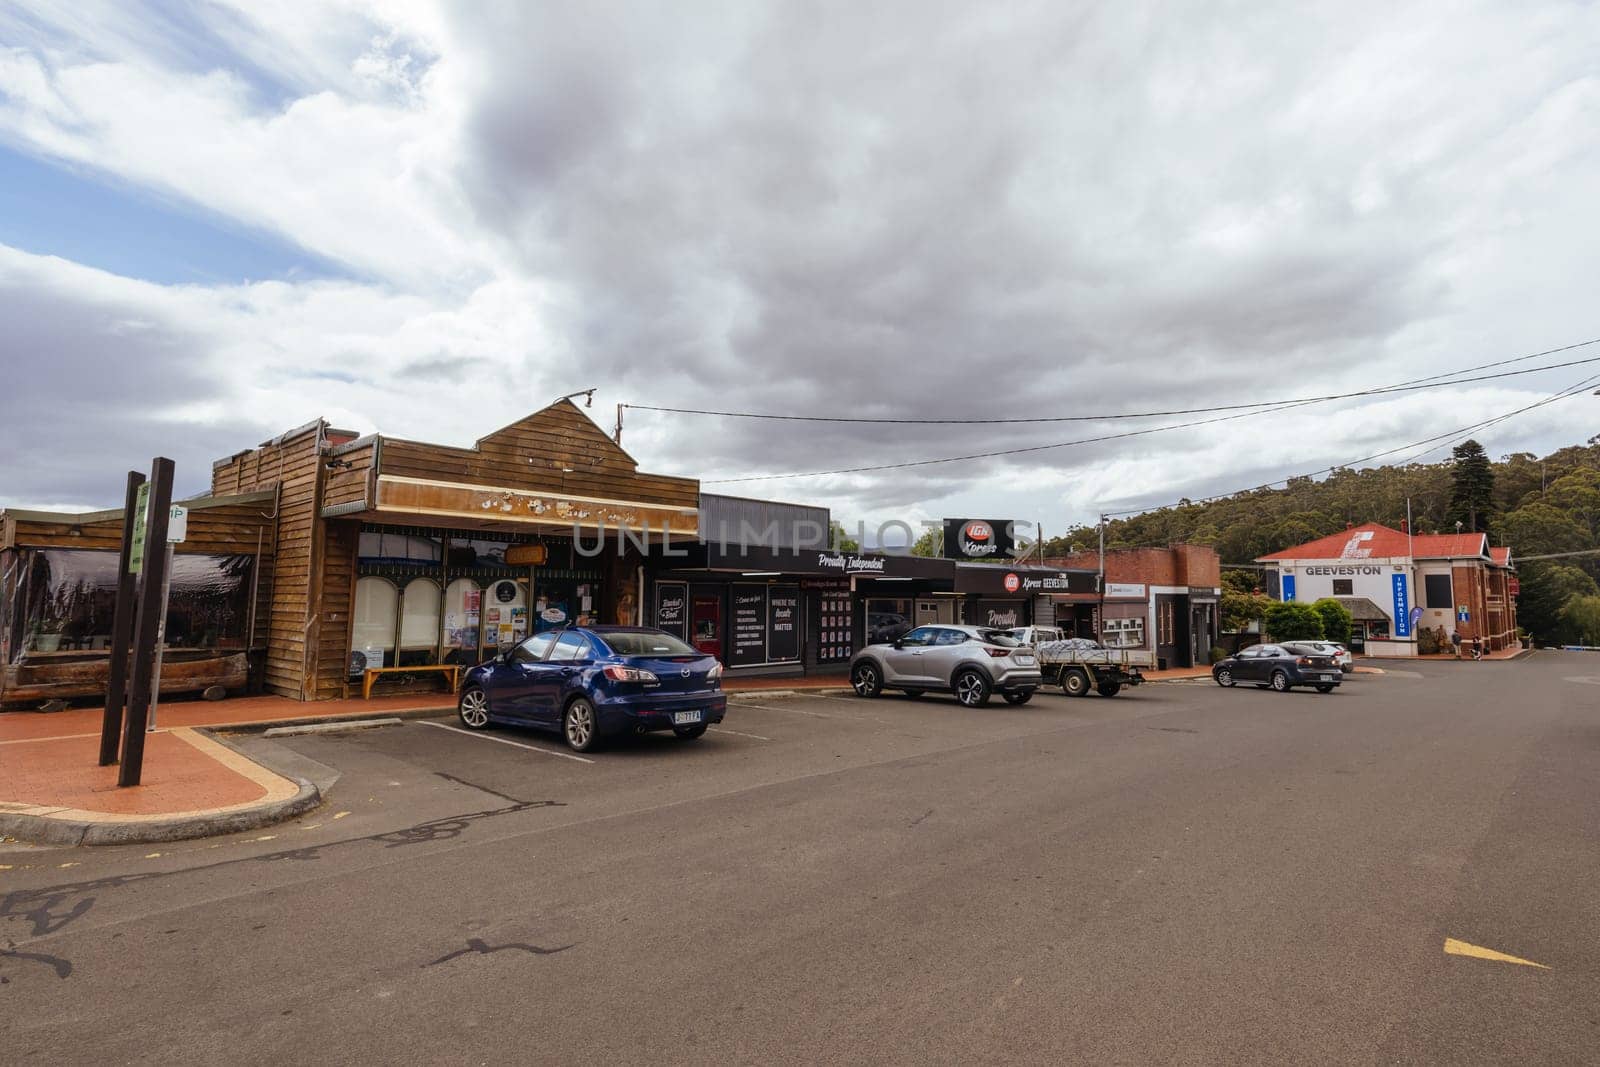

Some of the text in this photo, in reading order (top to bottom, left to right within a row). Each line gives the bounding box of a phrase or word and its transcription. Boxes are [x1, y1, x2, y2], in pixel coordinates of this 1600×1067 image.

[969, 525, 988, 536] IGA
[962, 541, 998, 556] Xpress
[818, 553, 886, 571] Proudly Independent
[1305, 566, 1382, 576] GEEVESTON
[1006, 577, 1069, 591] IGA Xpress GEEVESTON
[1396, 577, 1405, 633] INFORMATION
[987, 607, 1017, 628] Proudly
[774, 623, 793, 631] MATTER
